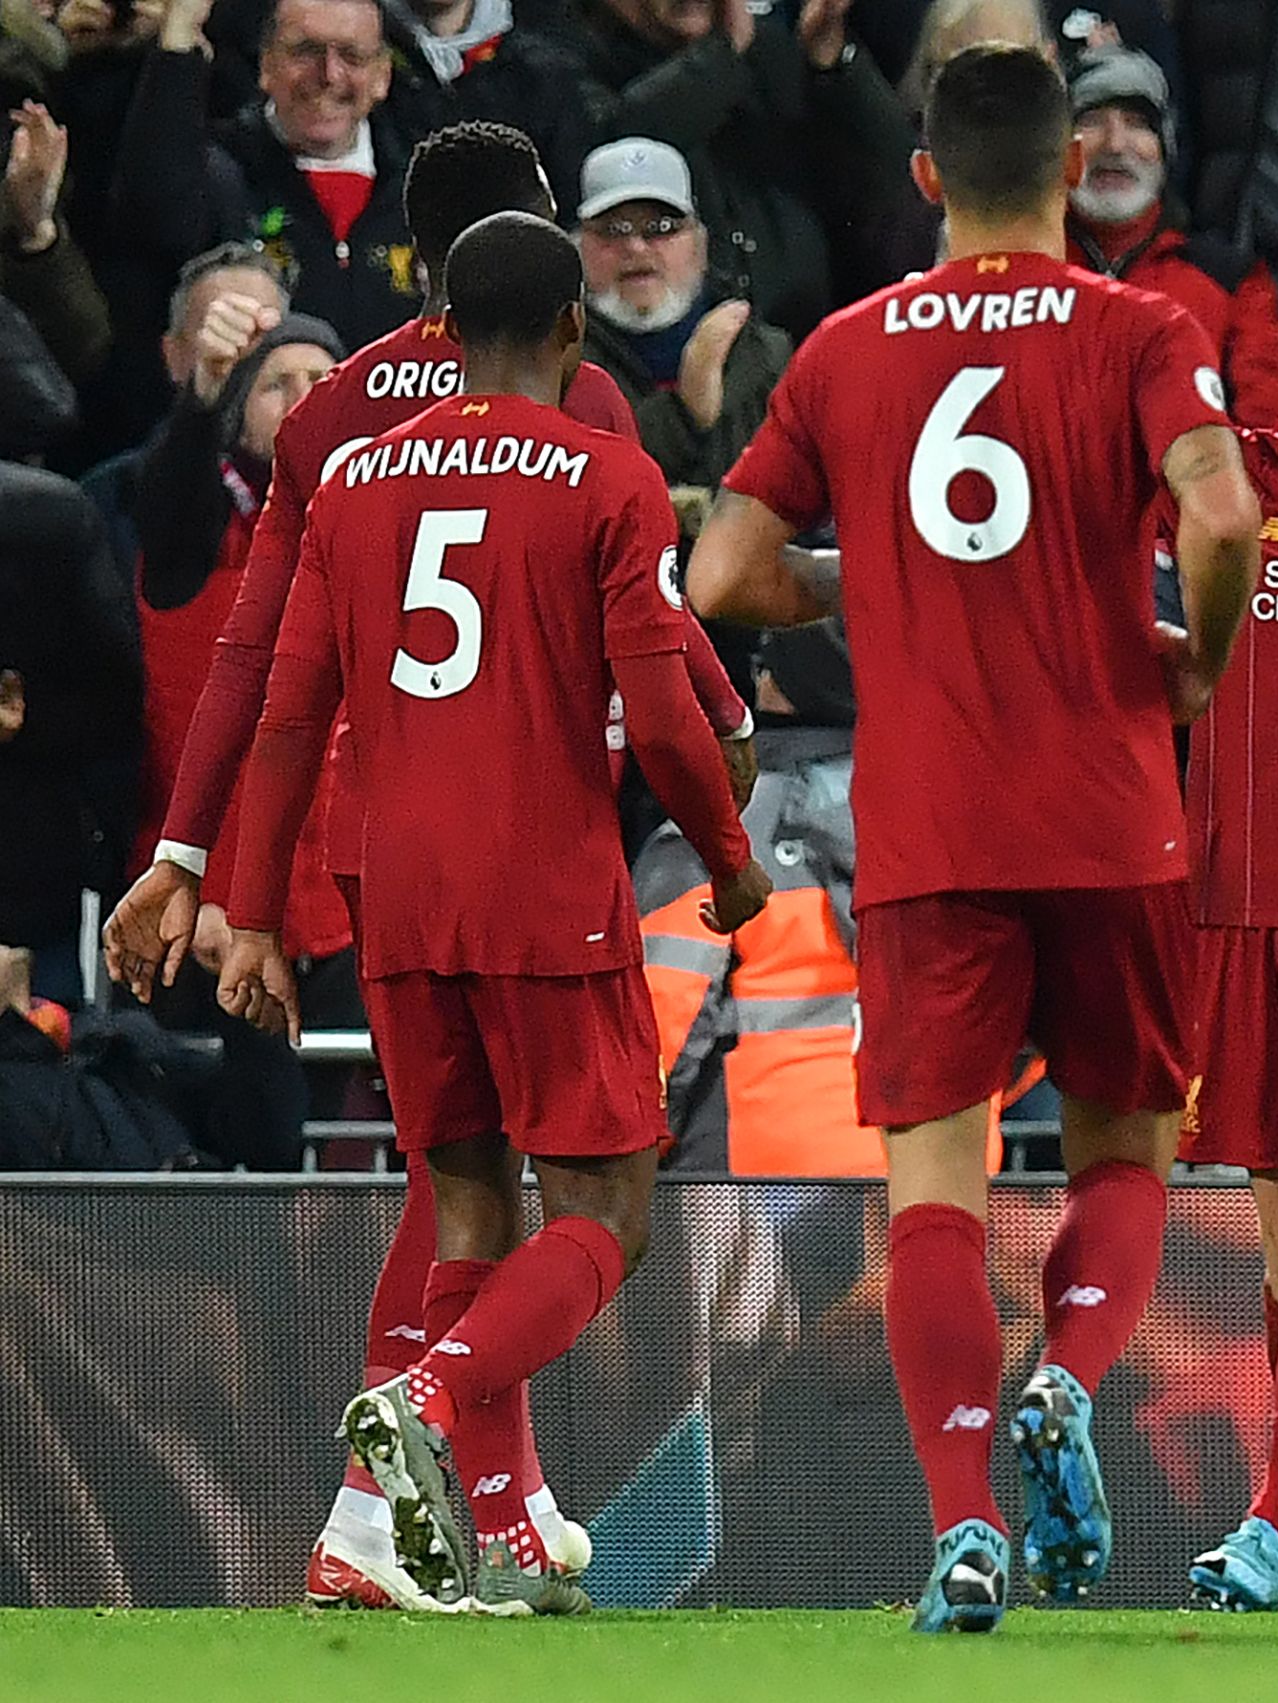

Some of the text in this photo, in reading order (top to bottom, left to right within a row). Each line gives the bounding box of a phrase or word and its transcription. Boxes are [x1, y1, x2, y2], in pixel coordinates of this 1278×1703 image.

[883, 286, 1077, 335] LOVREN
[345, 436, 590, 488] WIJNALDUM
[908, 366, 1032, 563] 6
[390, 508, 488, 699] 5
